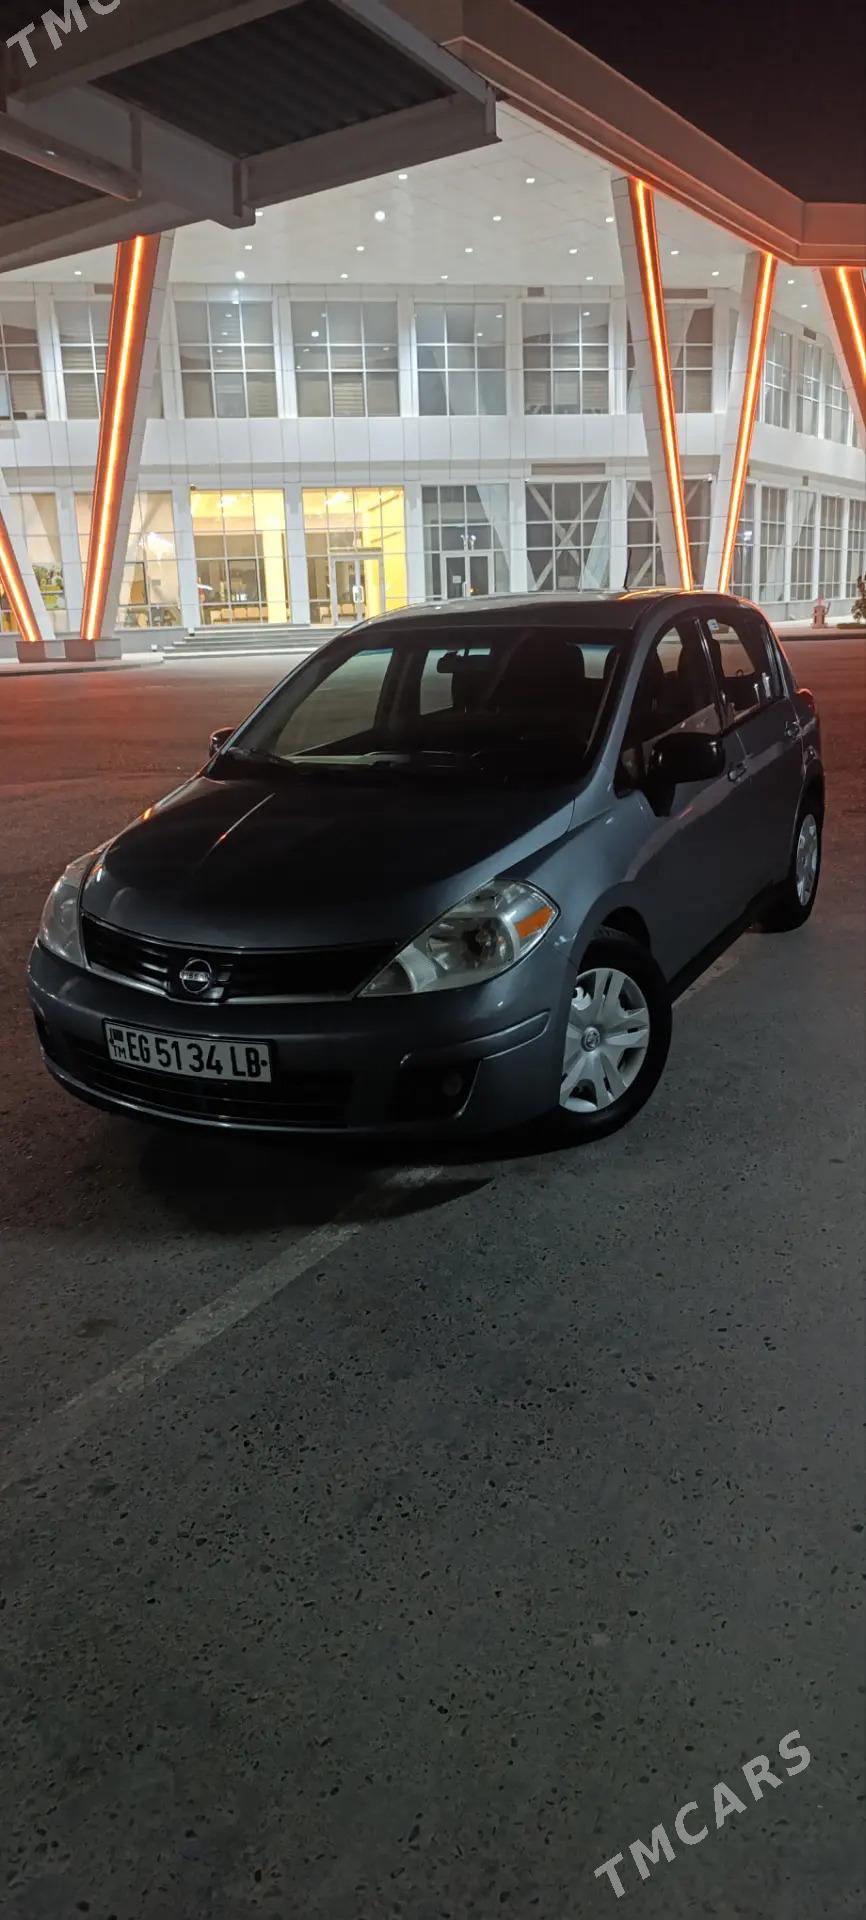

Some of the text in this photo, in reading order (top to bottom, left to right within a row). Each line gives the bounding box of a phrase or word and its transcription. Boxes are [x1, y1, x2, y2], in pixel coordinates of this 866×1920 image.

[111, 1044, 127, 1060] TM
[126, 1031, 151, 1064] EG
[229, 1046, 261, 1078] LB
